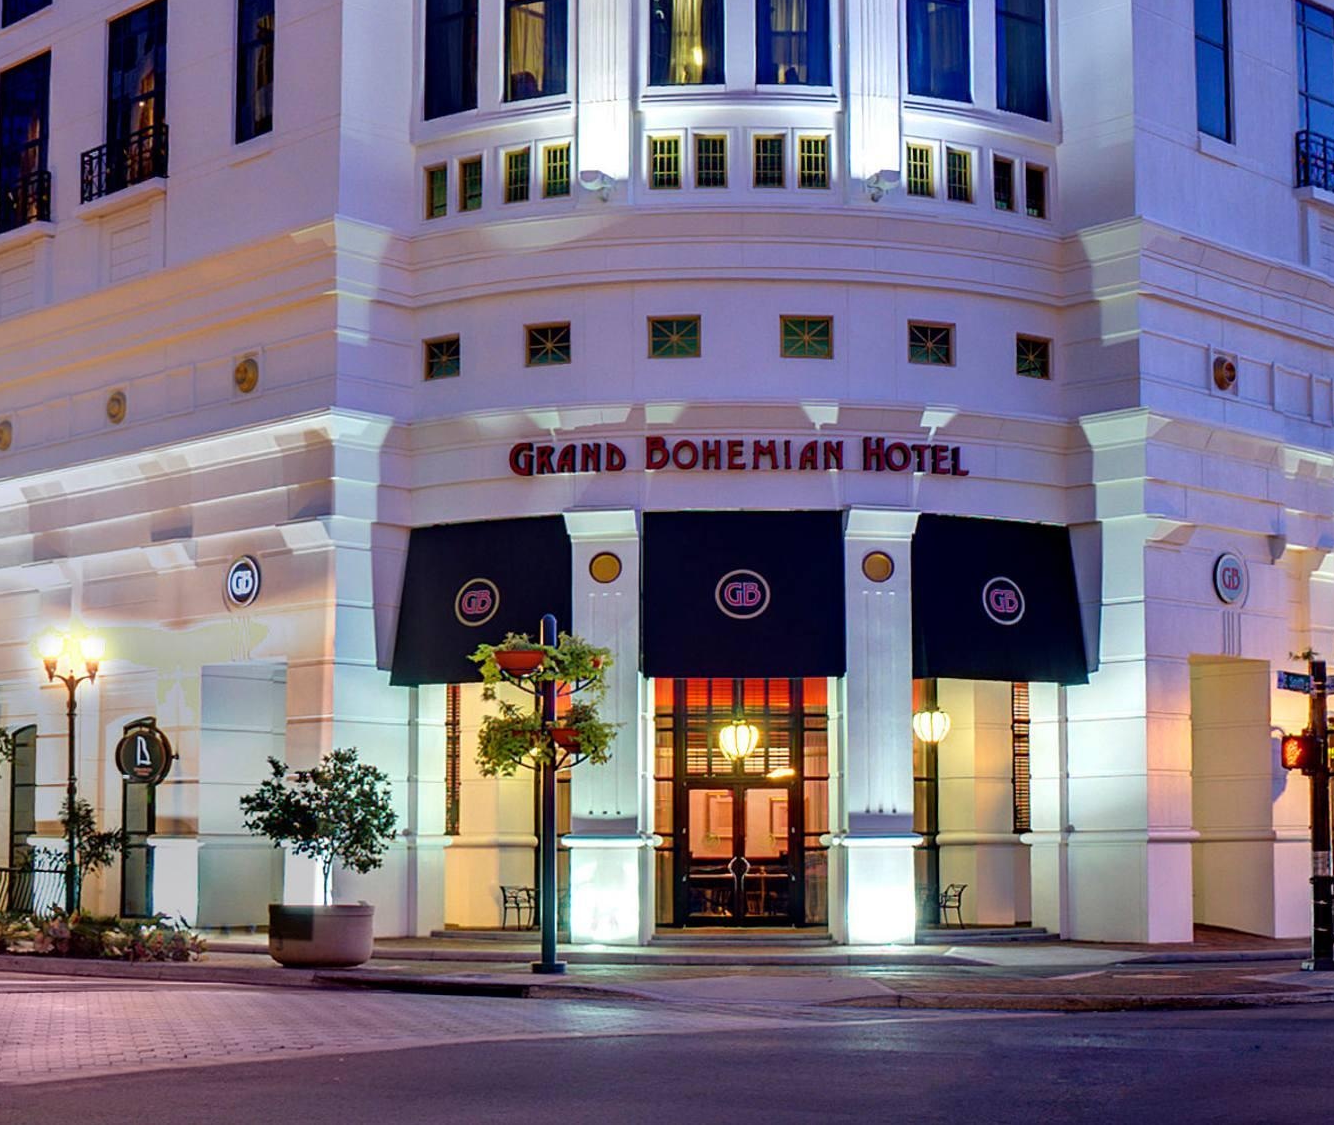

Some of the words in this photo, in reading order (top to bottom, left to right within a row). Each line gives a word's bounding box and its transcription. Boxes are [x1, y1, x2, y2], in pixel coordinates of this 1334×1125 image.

[509, 442, 627, 476] GRAND
[645, 436, 844, 471] BOHEMIAN
[863, 436, 969, 476] HOTEL
[1222, 567, 1241, 590] GB
[462, 590, 492, 615] GB
[724, 582, 761, 606] GB
[990, 589, 1019, 613] GB
